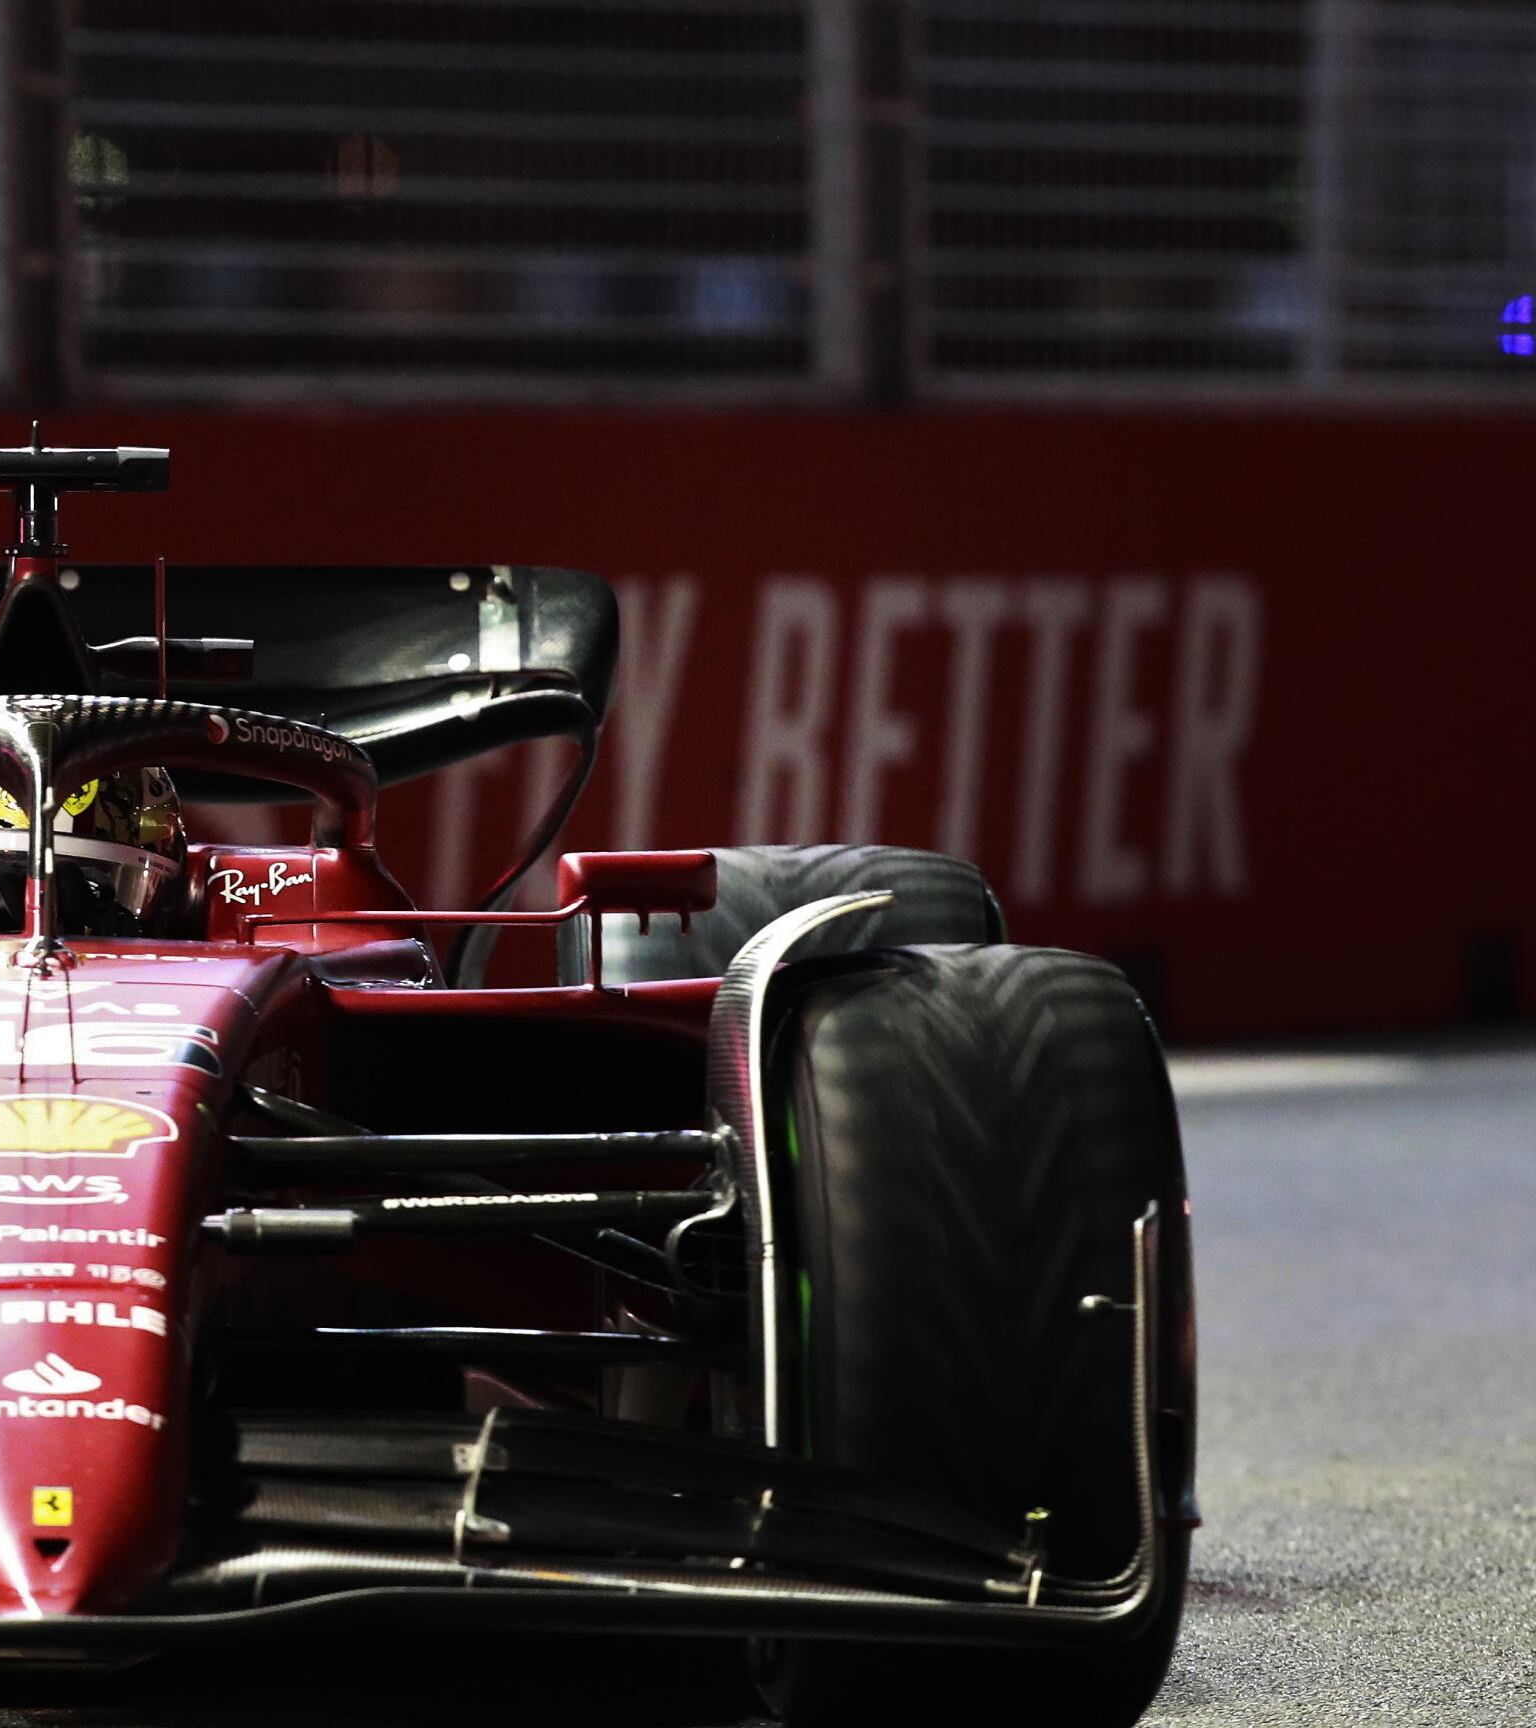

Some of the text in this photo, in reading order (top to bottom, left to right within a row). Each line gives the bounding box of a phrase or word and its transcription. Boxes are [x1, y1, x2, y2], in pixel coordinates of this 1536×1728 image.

[235, 717, 353, 762] Snapdragon
[732, 571, 1266, 906] BETTER
[207, 862, 313, 906] Ray-Ban
